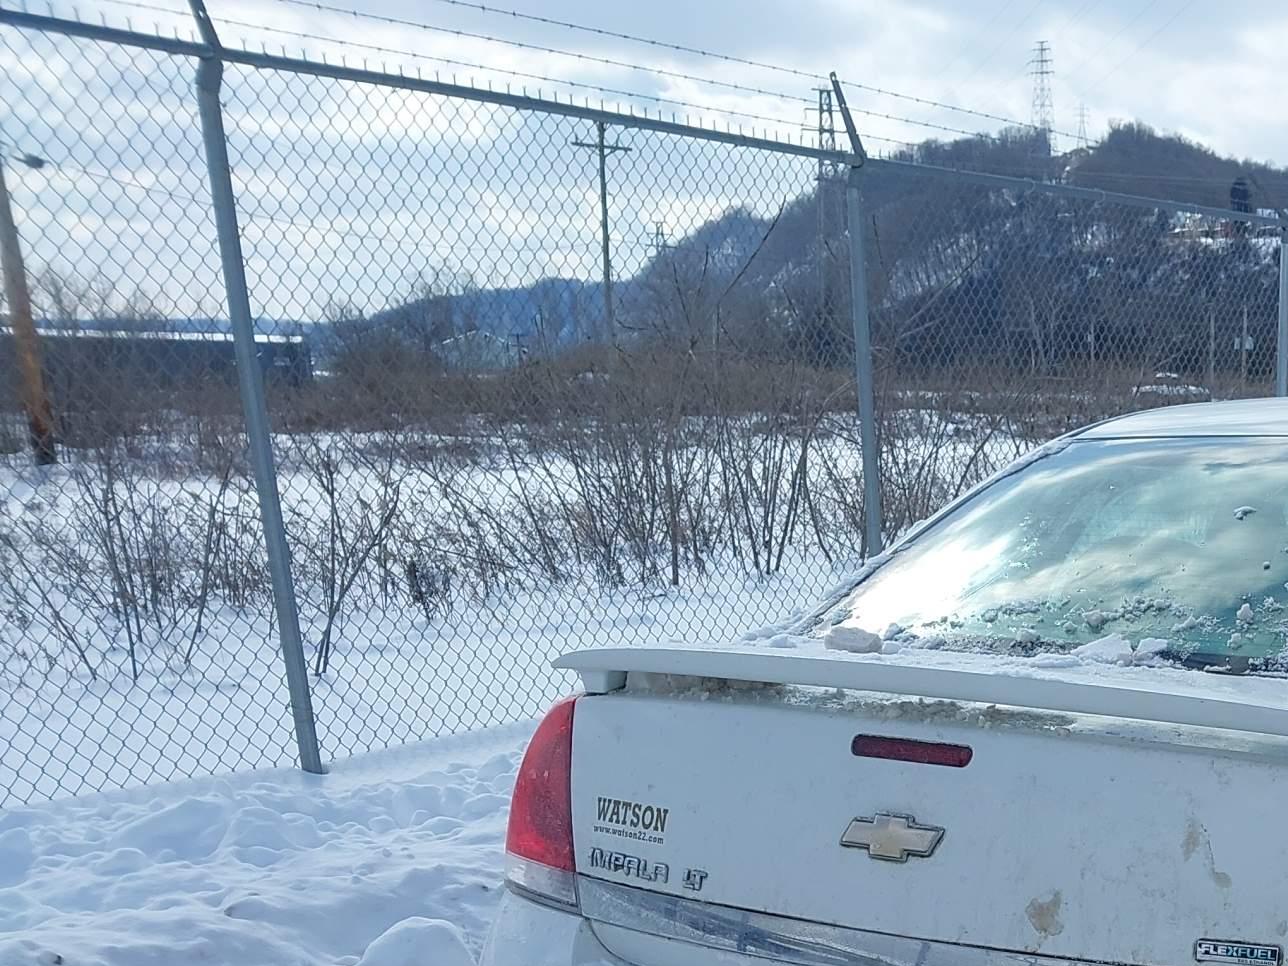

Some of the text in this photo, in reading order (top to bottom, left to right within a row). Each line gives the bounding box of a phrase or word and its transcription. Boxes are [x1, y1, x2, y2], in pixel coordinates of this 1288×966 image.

[597, 796, 669, 833] WATSON
[593, 825, 664, 845] www.watson22.com
[682, 868, 709, 892] LT
[1199, 943, 1276, 960] FLEXFUEL
